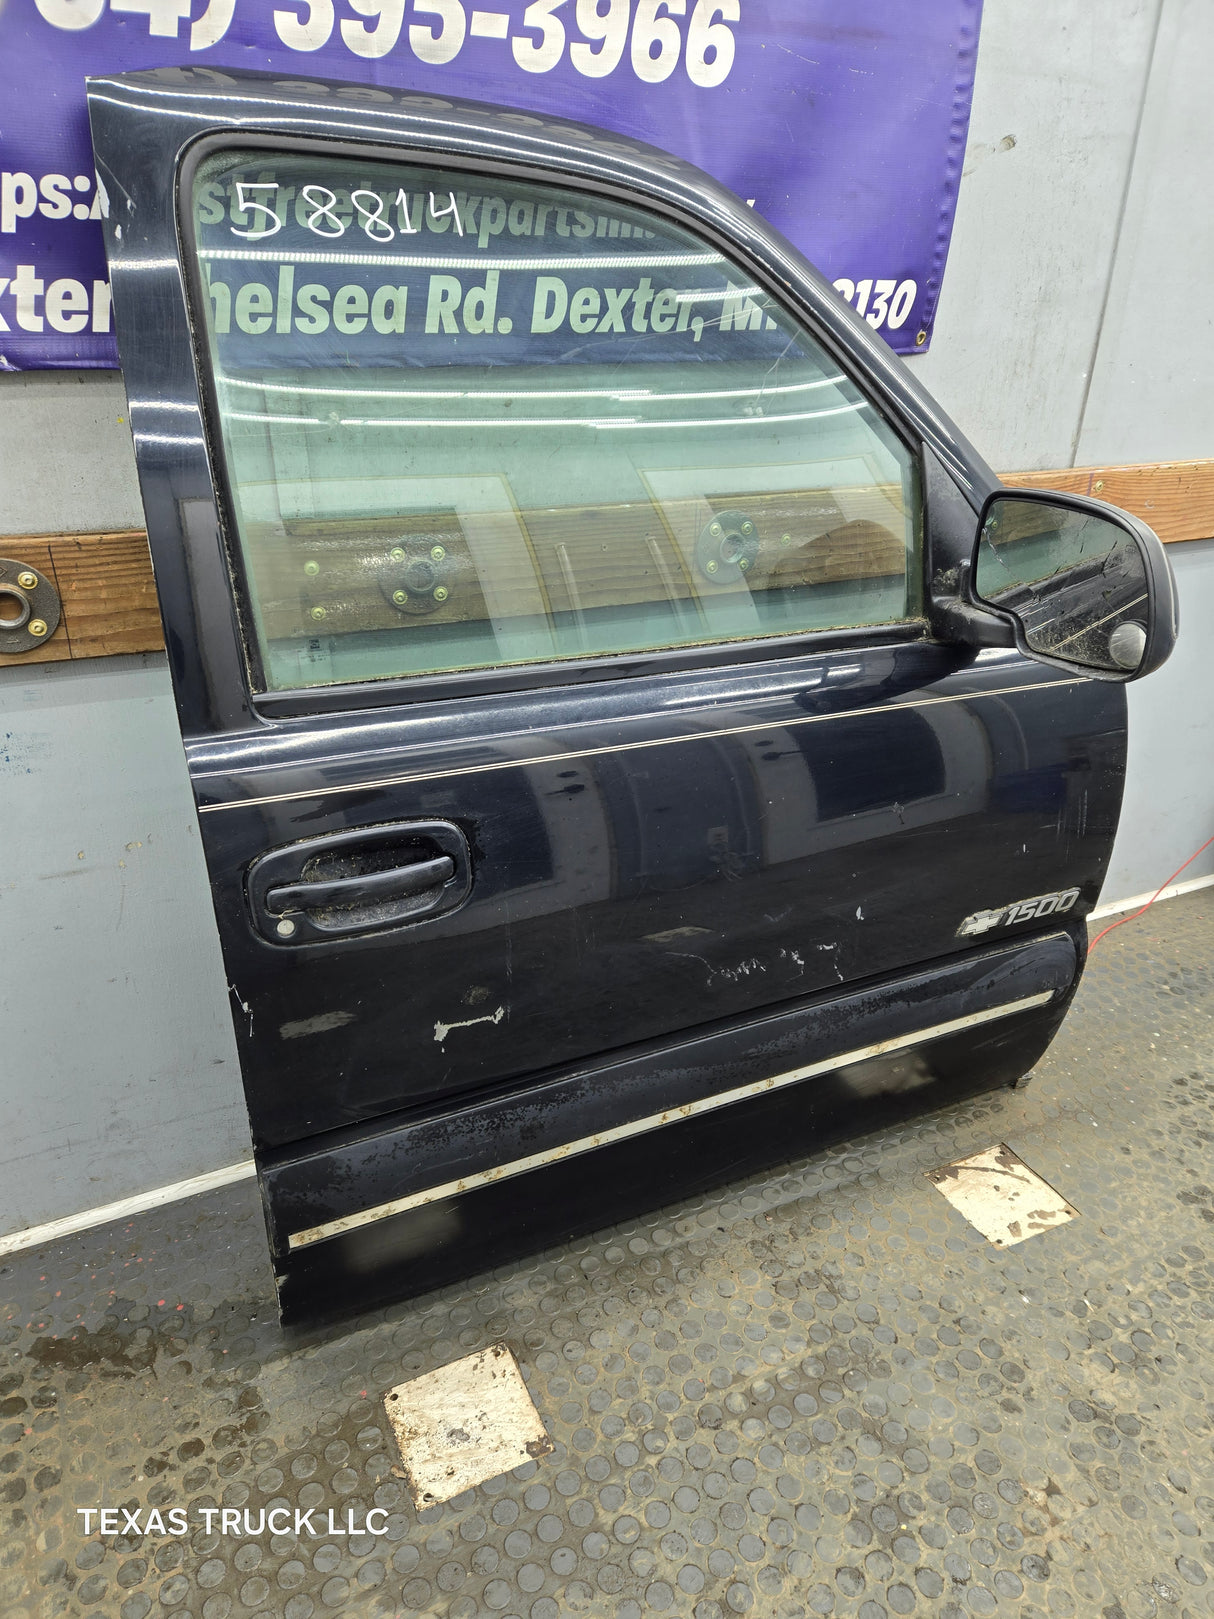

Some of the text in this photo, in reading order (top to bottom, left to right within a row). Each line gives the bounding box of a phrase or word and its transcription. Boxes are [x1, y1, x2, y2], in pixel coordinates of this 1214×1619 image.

[0, 265, 113, 333] ter
[425, 270, 513, 334] Rd.
[531, 276, 704, 342] Dexter,
[719, 280, 778, 331] M
[1004, 888, 1081, 926] 1500
